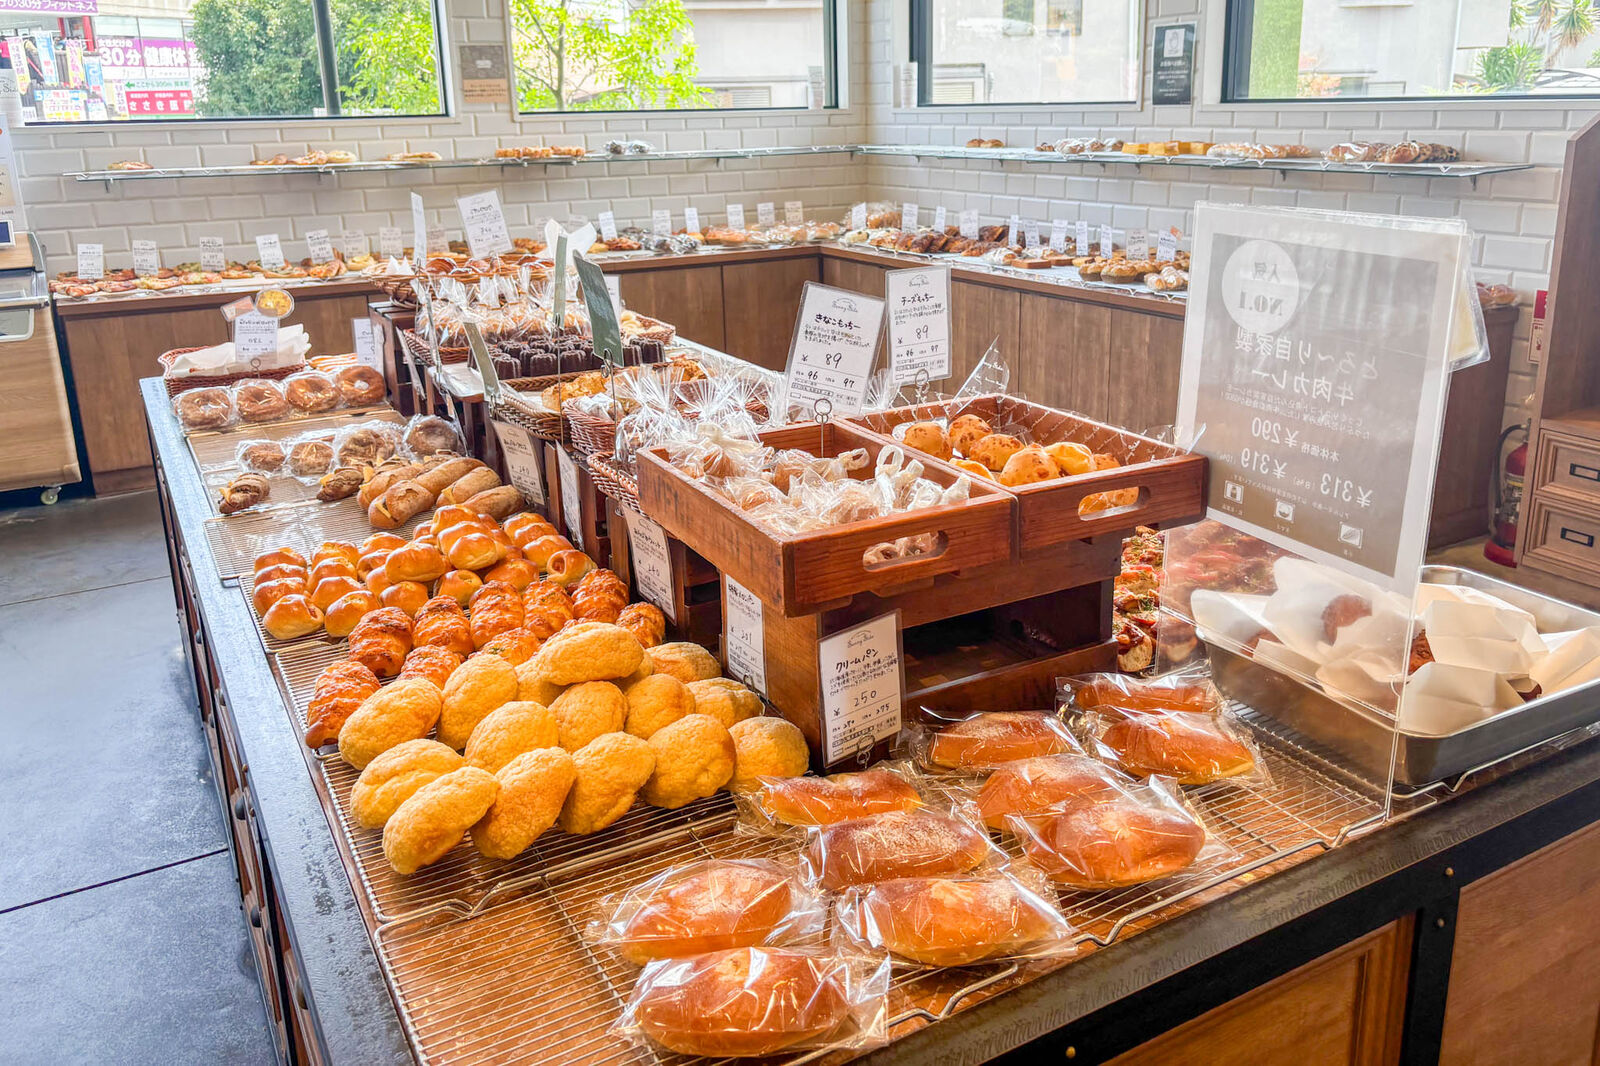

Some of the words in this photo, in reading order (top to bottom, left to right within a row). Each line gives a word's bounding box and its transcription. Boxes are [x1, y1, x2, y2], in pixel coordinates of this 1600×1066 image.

[814, 313, 861, 330] きなこもっちー
[825, 352, 843, 369] 89
[807, 370, 818, 381] 96
[843, 377, 855, 388] 97
[836, 648, 879, 673] クリームパン
[854, 690, 877, 707] 250
